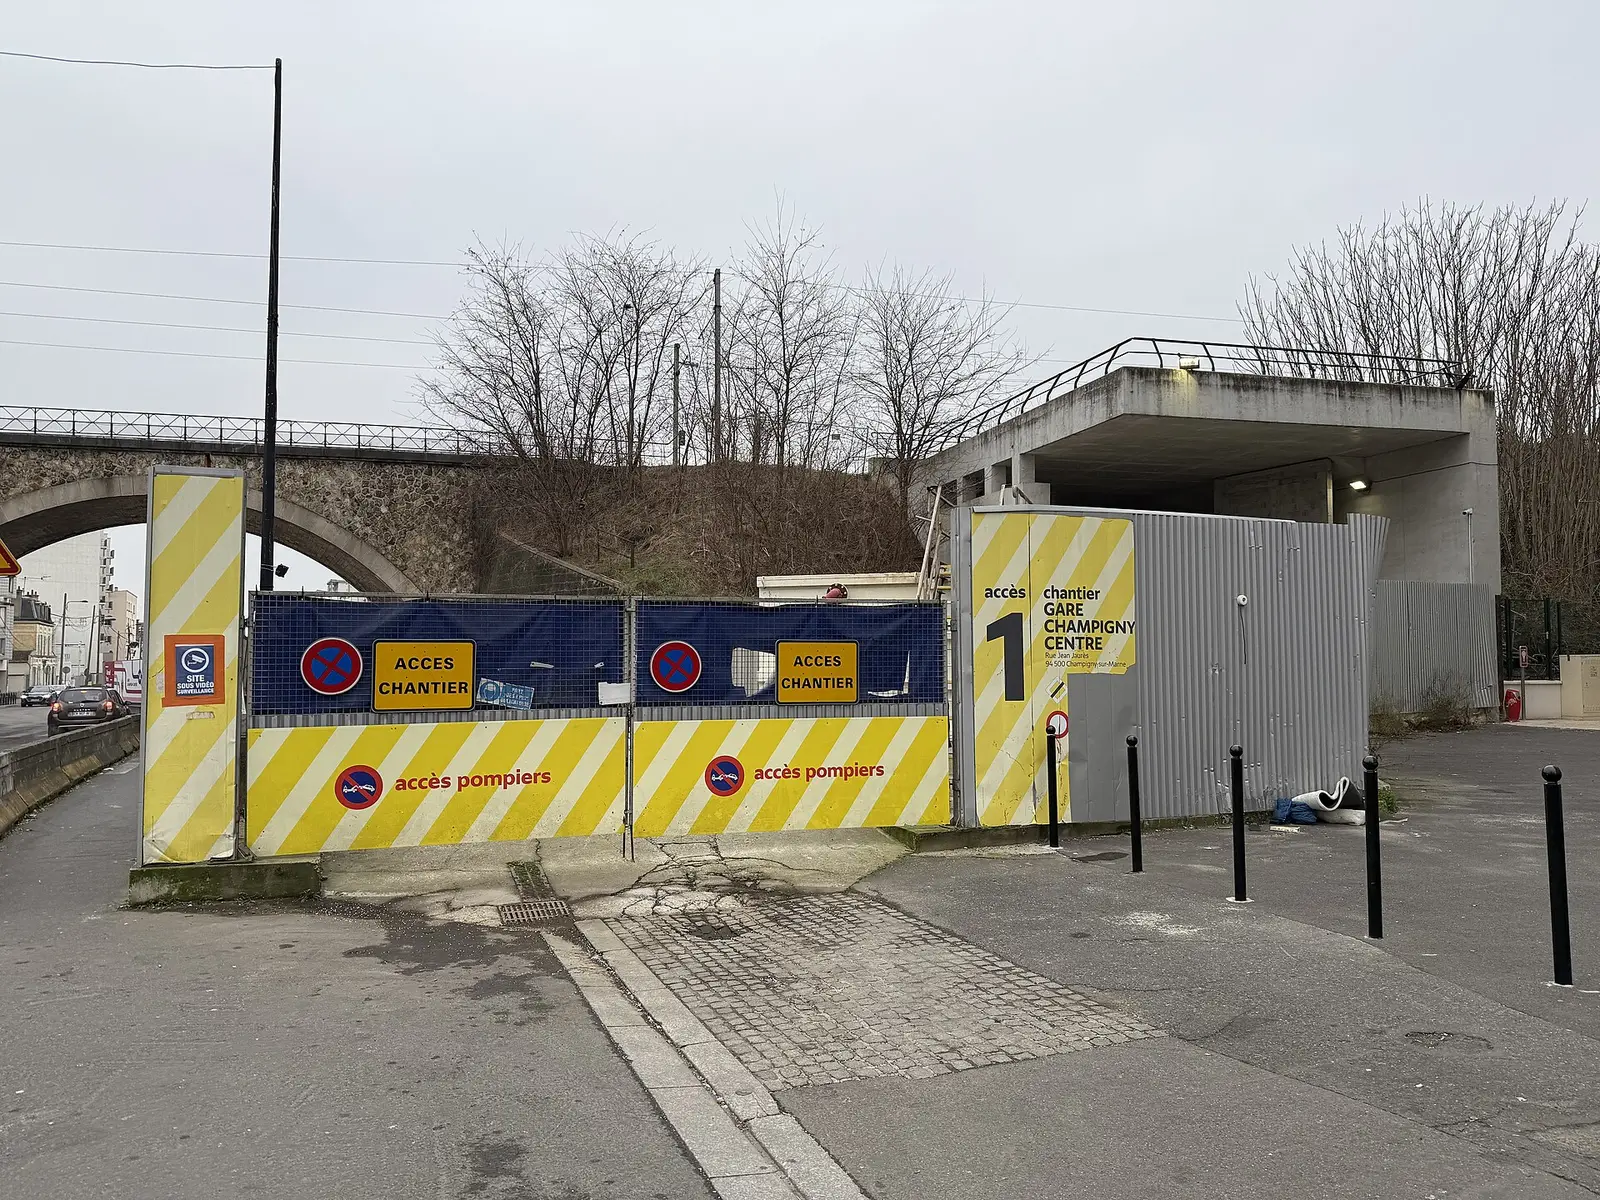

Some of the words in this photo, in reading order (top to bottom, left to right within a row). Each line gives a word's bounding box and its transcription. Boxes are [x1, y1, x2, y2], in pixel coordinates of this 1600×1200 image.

[984, 583, 1026, 599] accès
[1043, 584, 1101, 600] chantier
[1043, 602, 1084, 617] GARE
[1043, 619, 1136, 635] CHAMPIGNY
[1044, 636, 1103, 651] CENTRE
[793, 655, 842, 667] ACCES
[986, 612, 1025, 702] 1
[1045, 651, 1057, 659] Rue
[1057, 651, 1071, 659] Jean
[1071, 651, 1089, 659] Jaurès
[394, 657, 454, 670] ACCES
[1066, 660, 1127, 669] Champigny-sur-Marne
[177, 682, 195, 690] SOUS
[196, 680, 214, 689] VIDÉO
[186, 674, 205, 683] SITE
[781, 677, 854, 689] CHANTIER
[378, 681, 469, 695] CHANTIER
[754, 763, 801, 780] accès
[805, 762, 885, 783] pompiers
[394, 772, 452, 791] accès
[457, 768, 552, 793] pompiers
